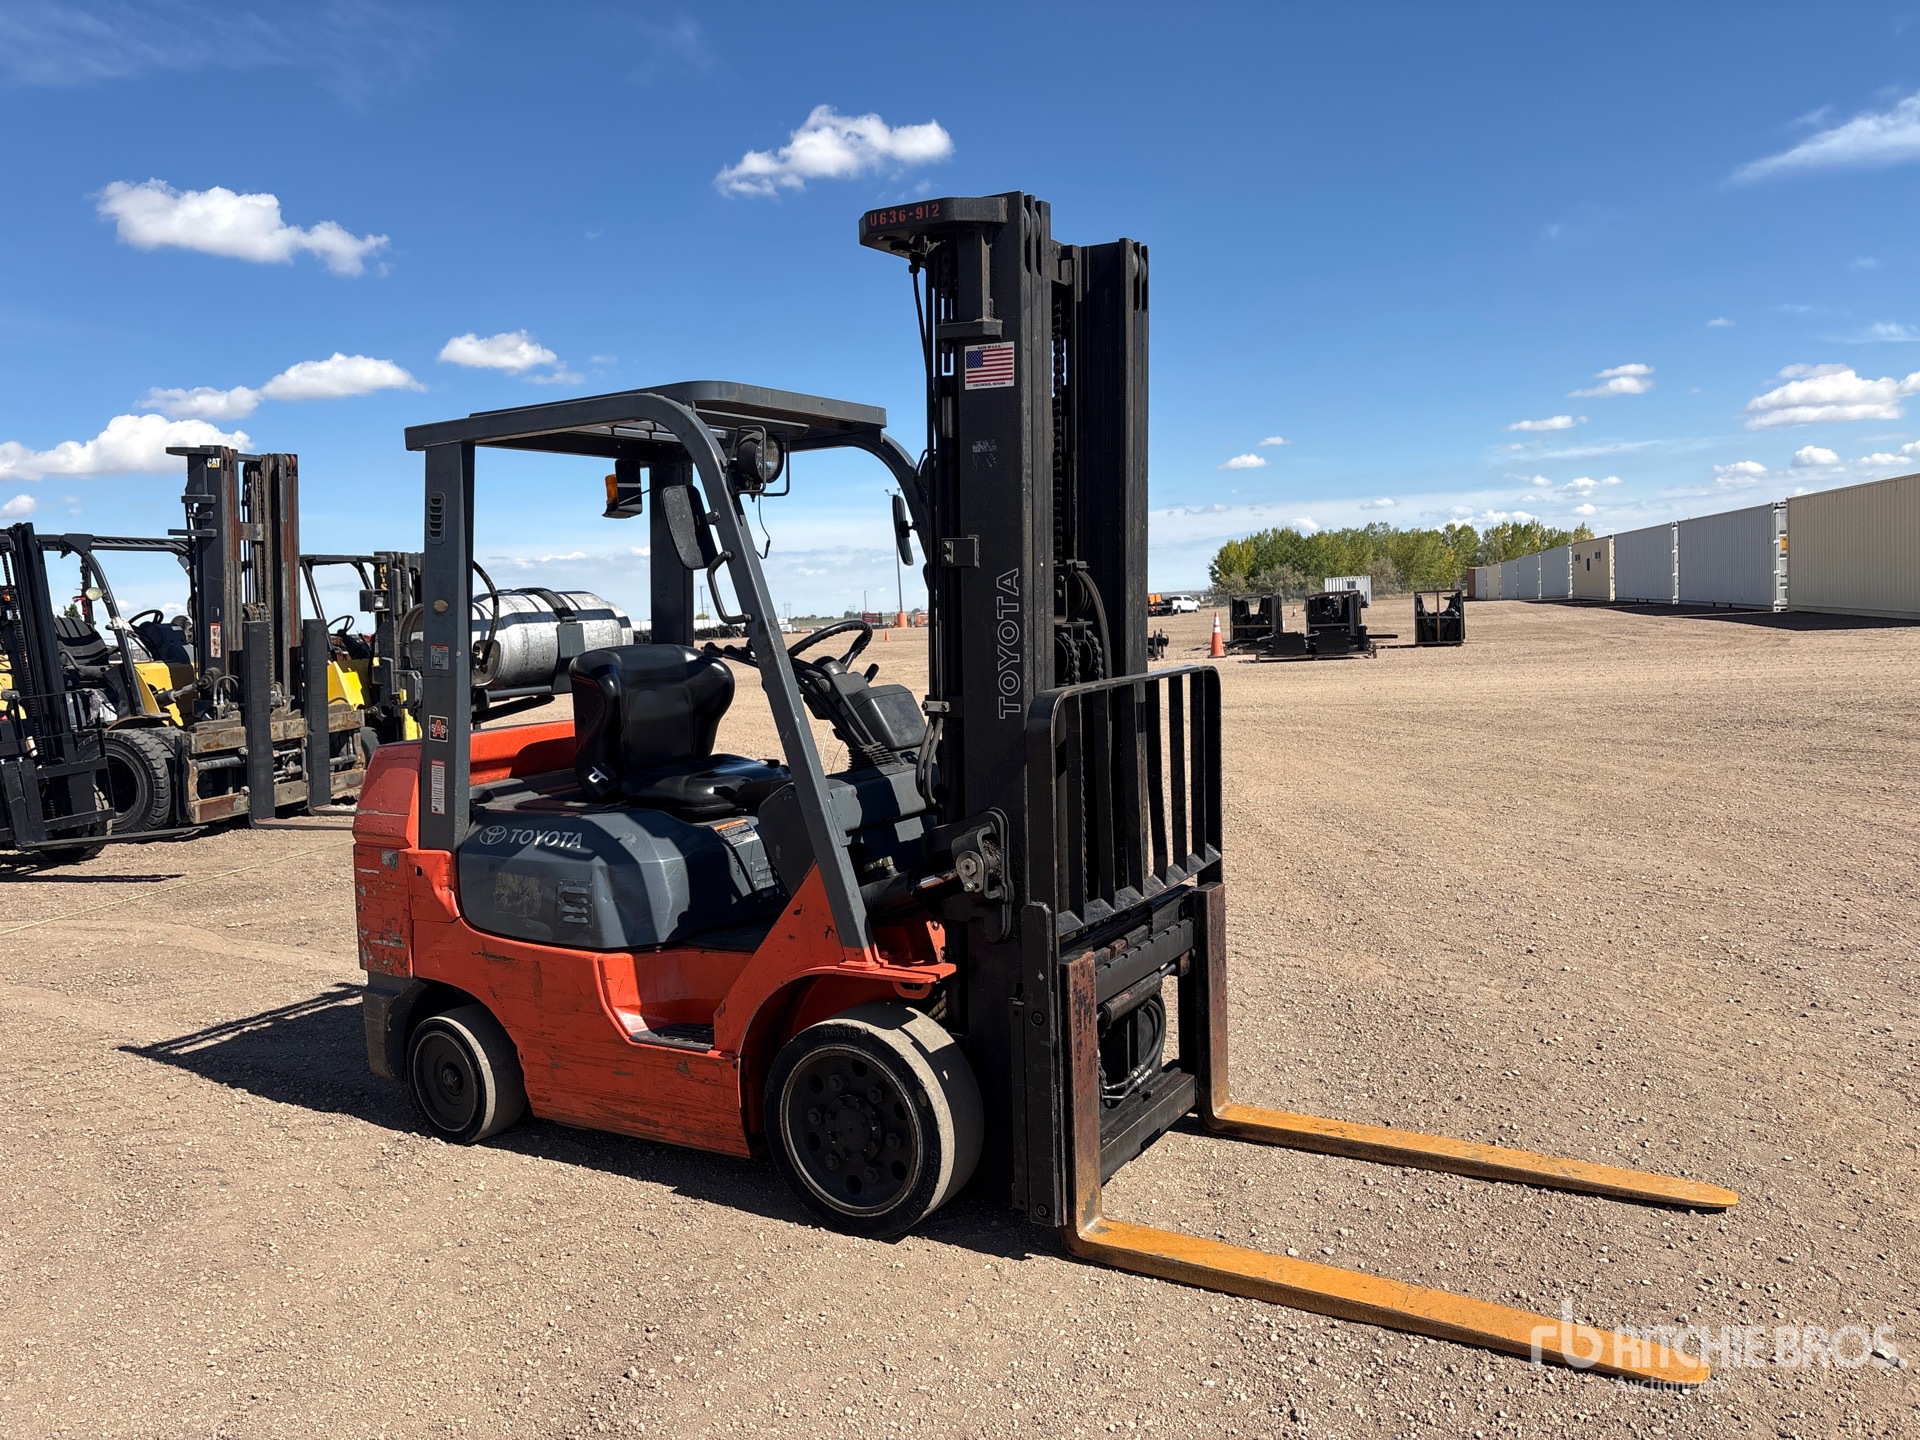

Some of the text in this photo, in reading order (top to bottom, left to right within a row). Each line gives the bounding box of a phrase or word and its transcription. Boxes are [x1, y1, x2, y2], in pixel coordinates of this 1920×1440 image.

[870, 203, 940, 227] U636-912
[207, 457, 221, 468] CAT
[996, 567, 1022, 720] TOYOTA
[509, 828, 583, 849] TOYOTA
